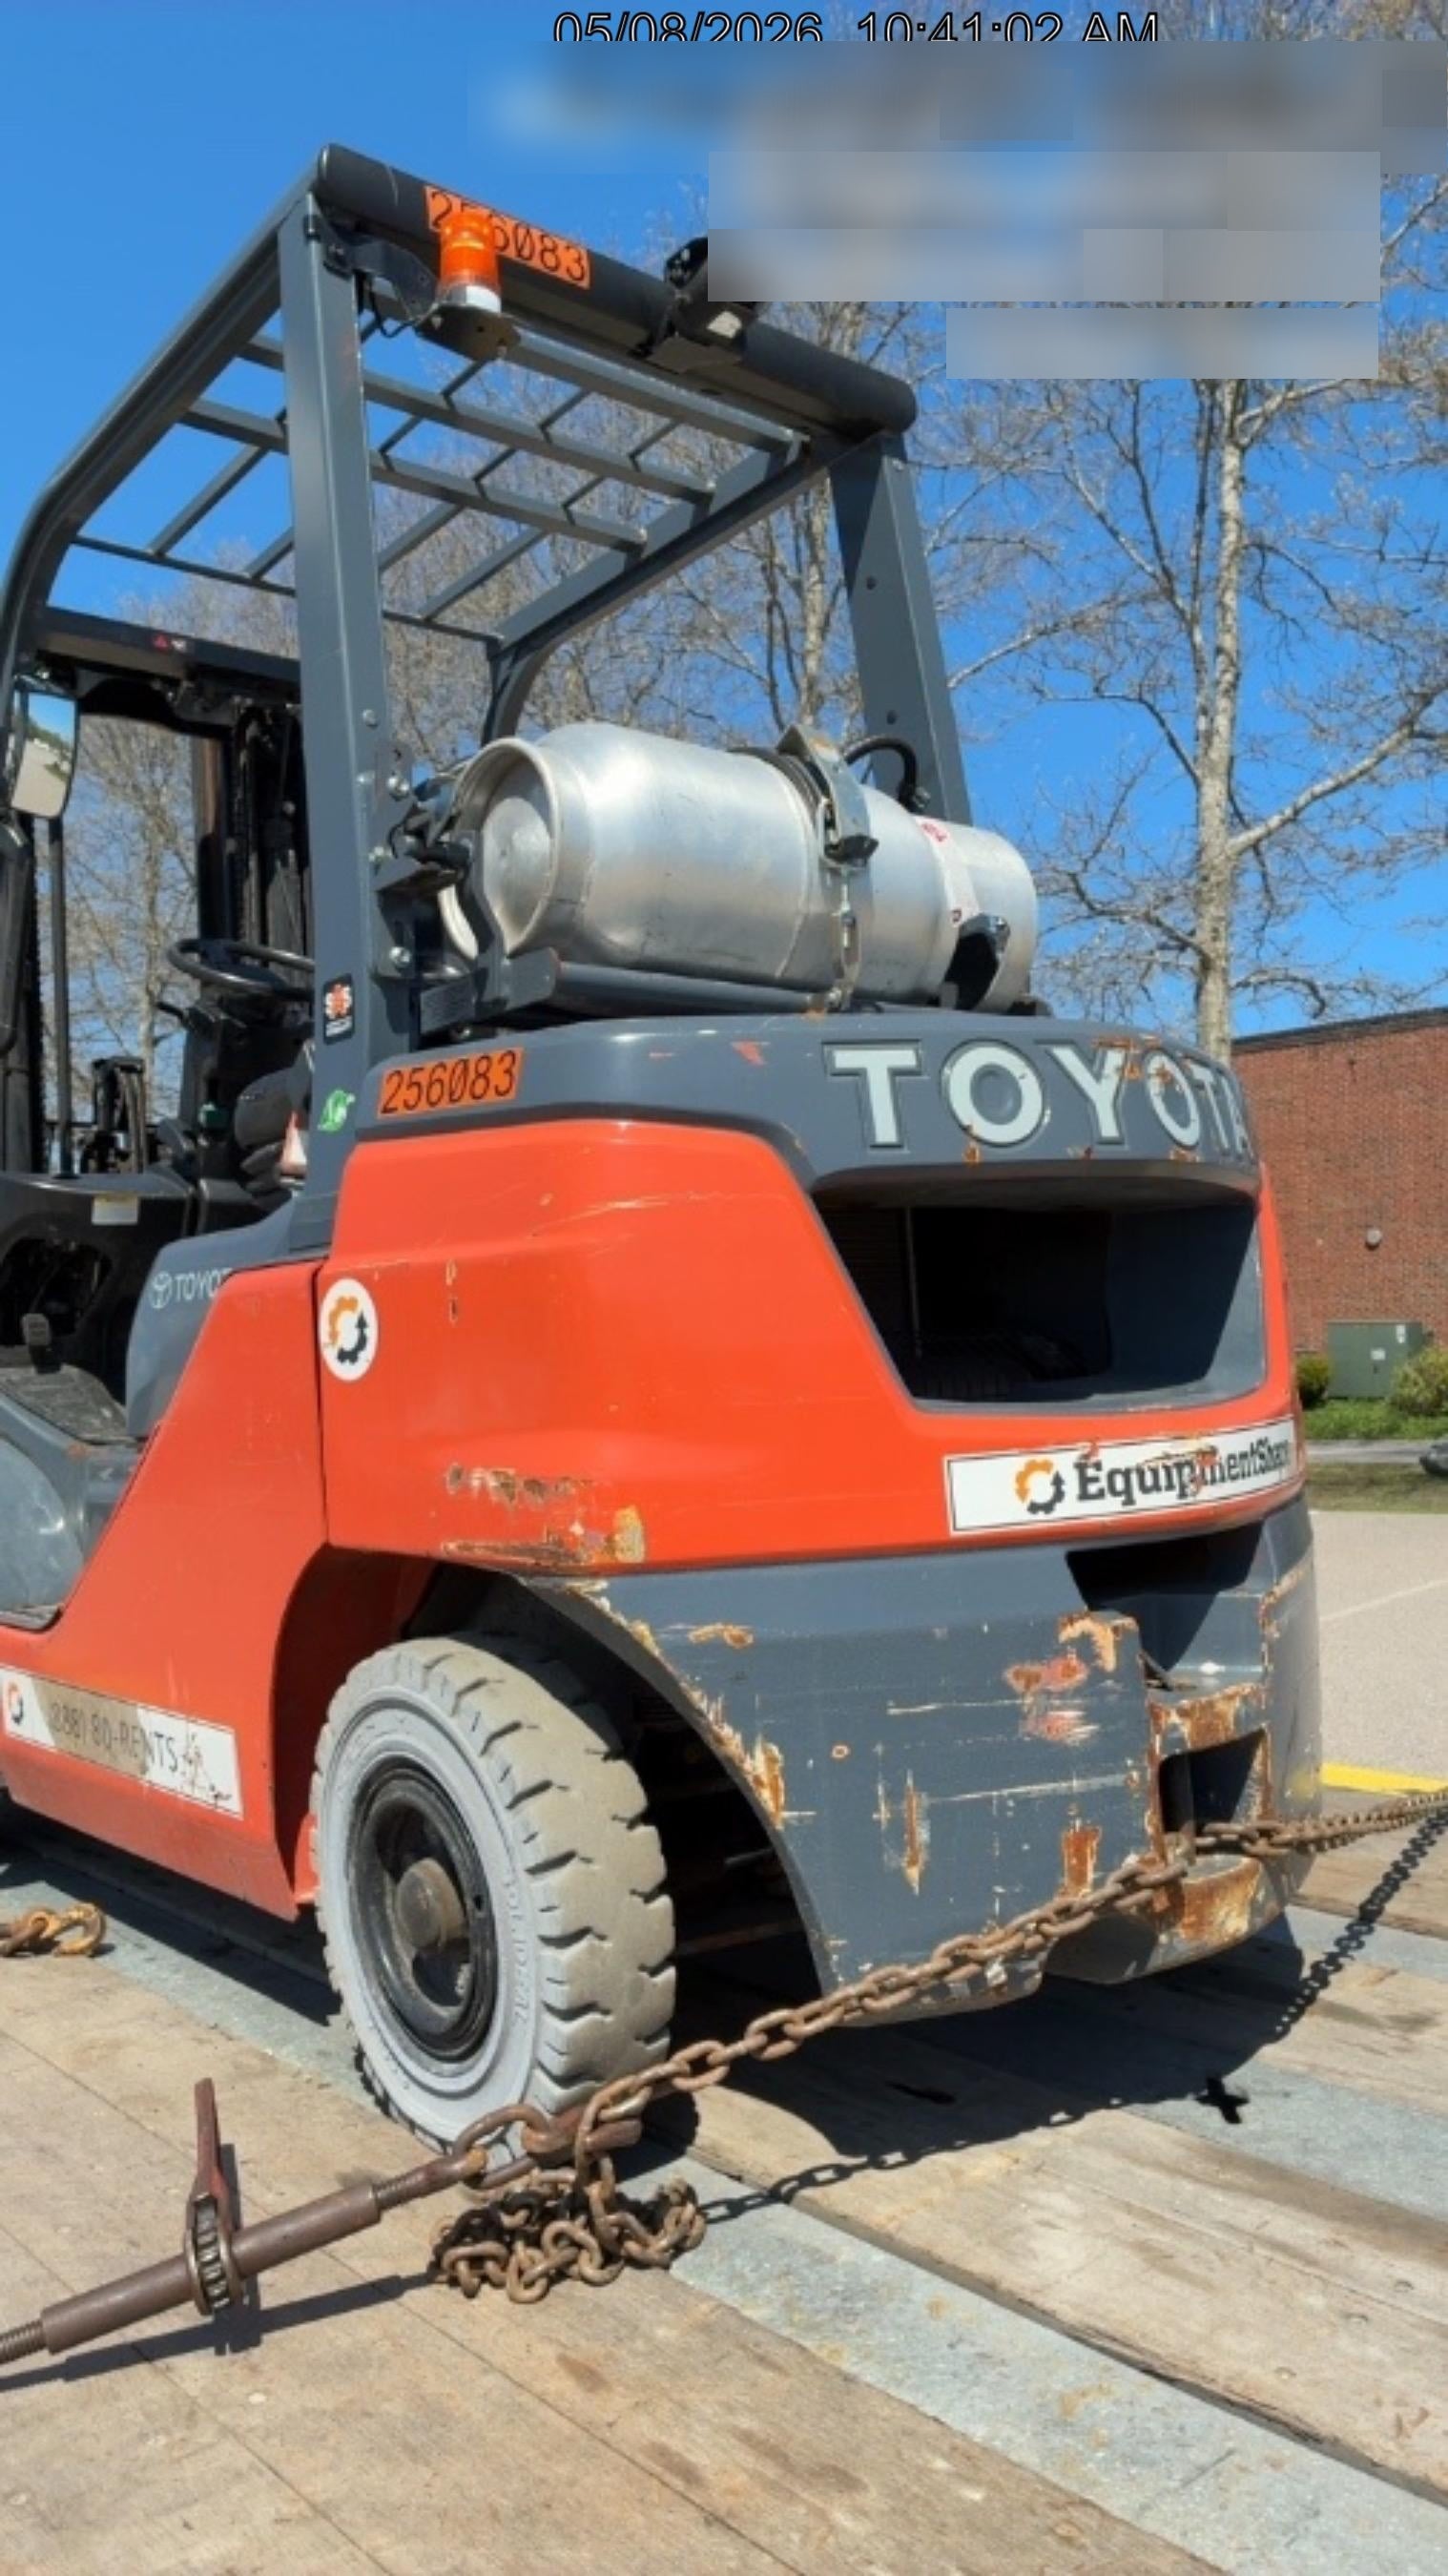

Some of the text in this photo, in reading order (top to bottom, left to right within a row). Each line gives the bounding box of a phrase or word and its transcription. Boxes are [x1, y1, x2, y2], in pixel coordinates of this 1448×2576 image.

[431, 191, 586, 282] 26083
[381, 1049, 517, 1114] 256083
[826, 1040, 1255, 1157] TOYOTA
